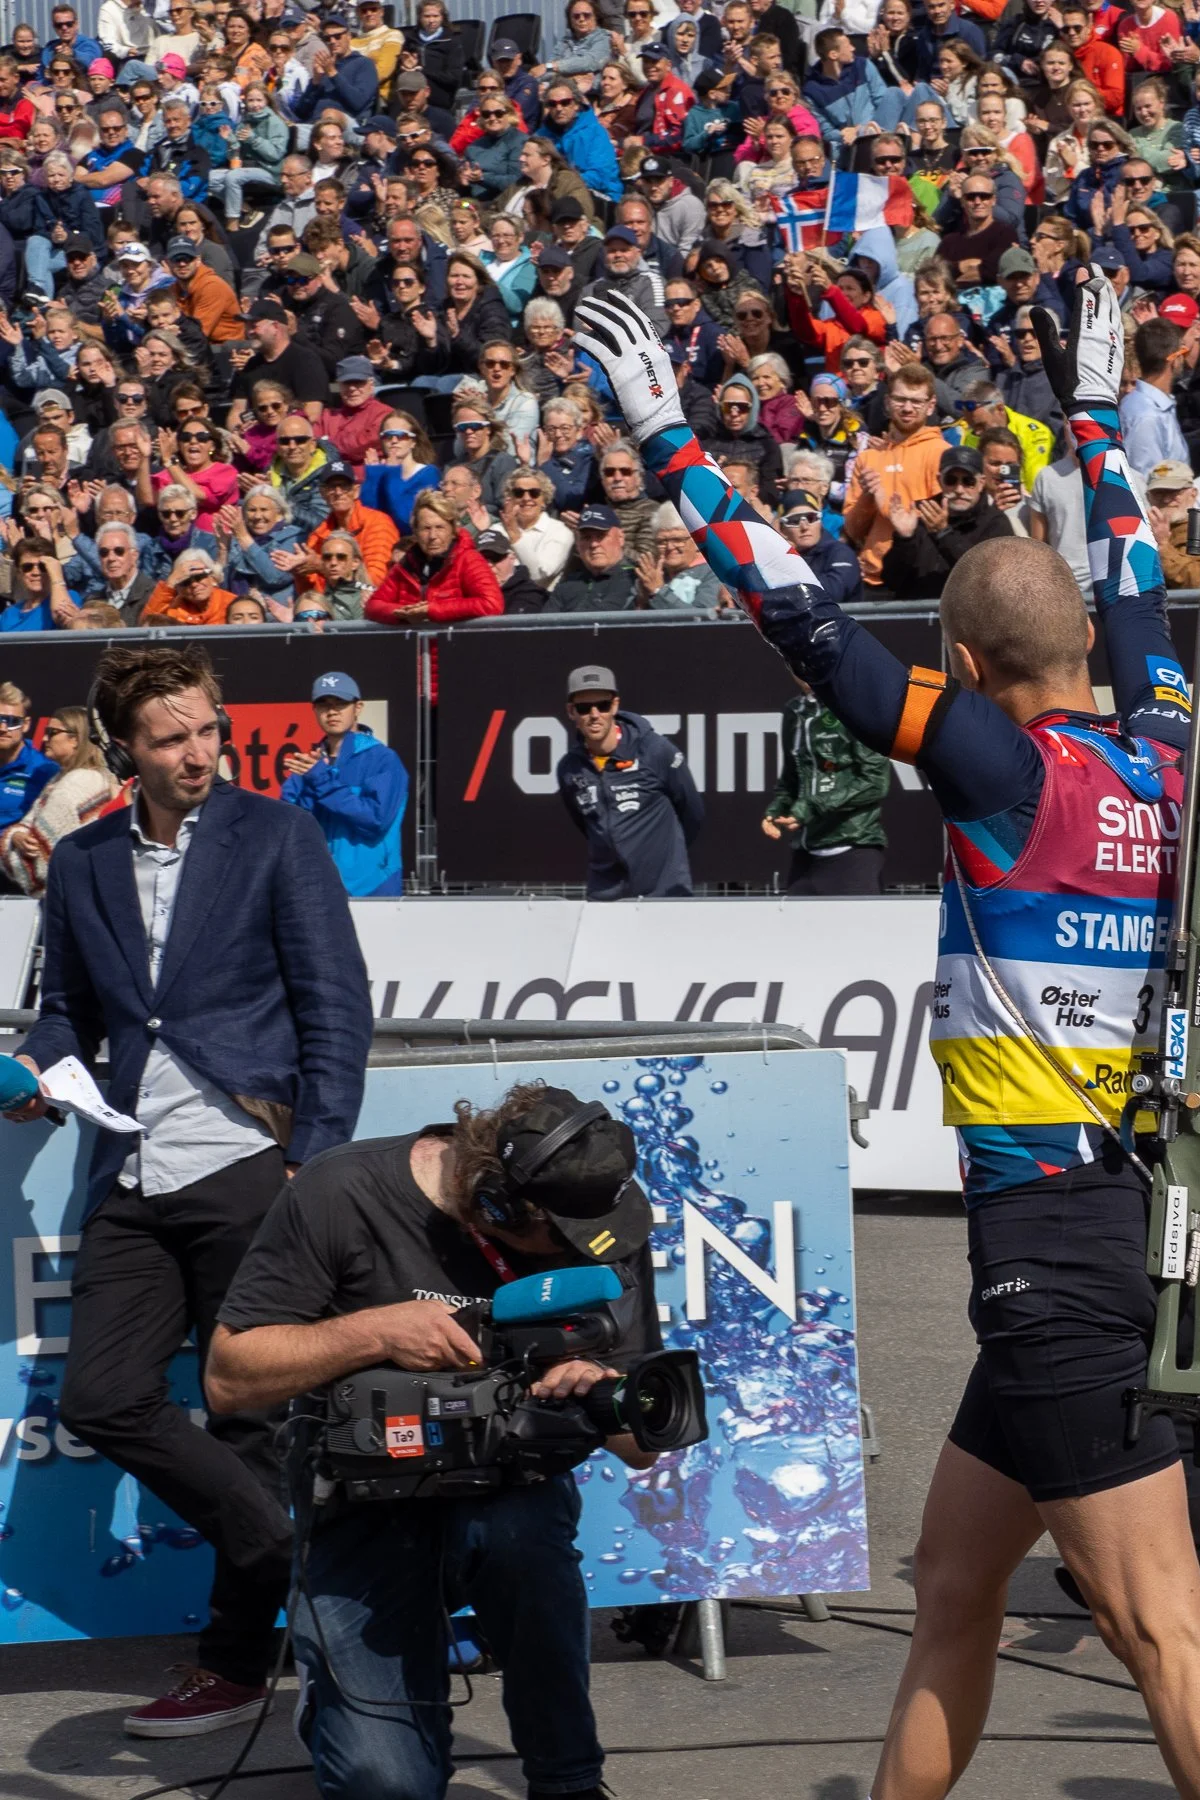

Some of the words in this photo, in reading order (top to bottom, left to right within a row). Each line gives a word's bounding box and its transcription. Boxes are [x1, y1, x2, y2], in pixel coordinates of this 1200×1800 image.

[1040, 985, 1102, 1008] Øster
[1055, 1007, 1096, 1028] Hus
[1169, 1012, 1186, 1079] HOKA
[980, 1280, 1015, 1301] CRAFT
[392, 1430, 415, 1443] Ta9
